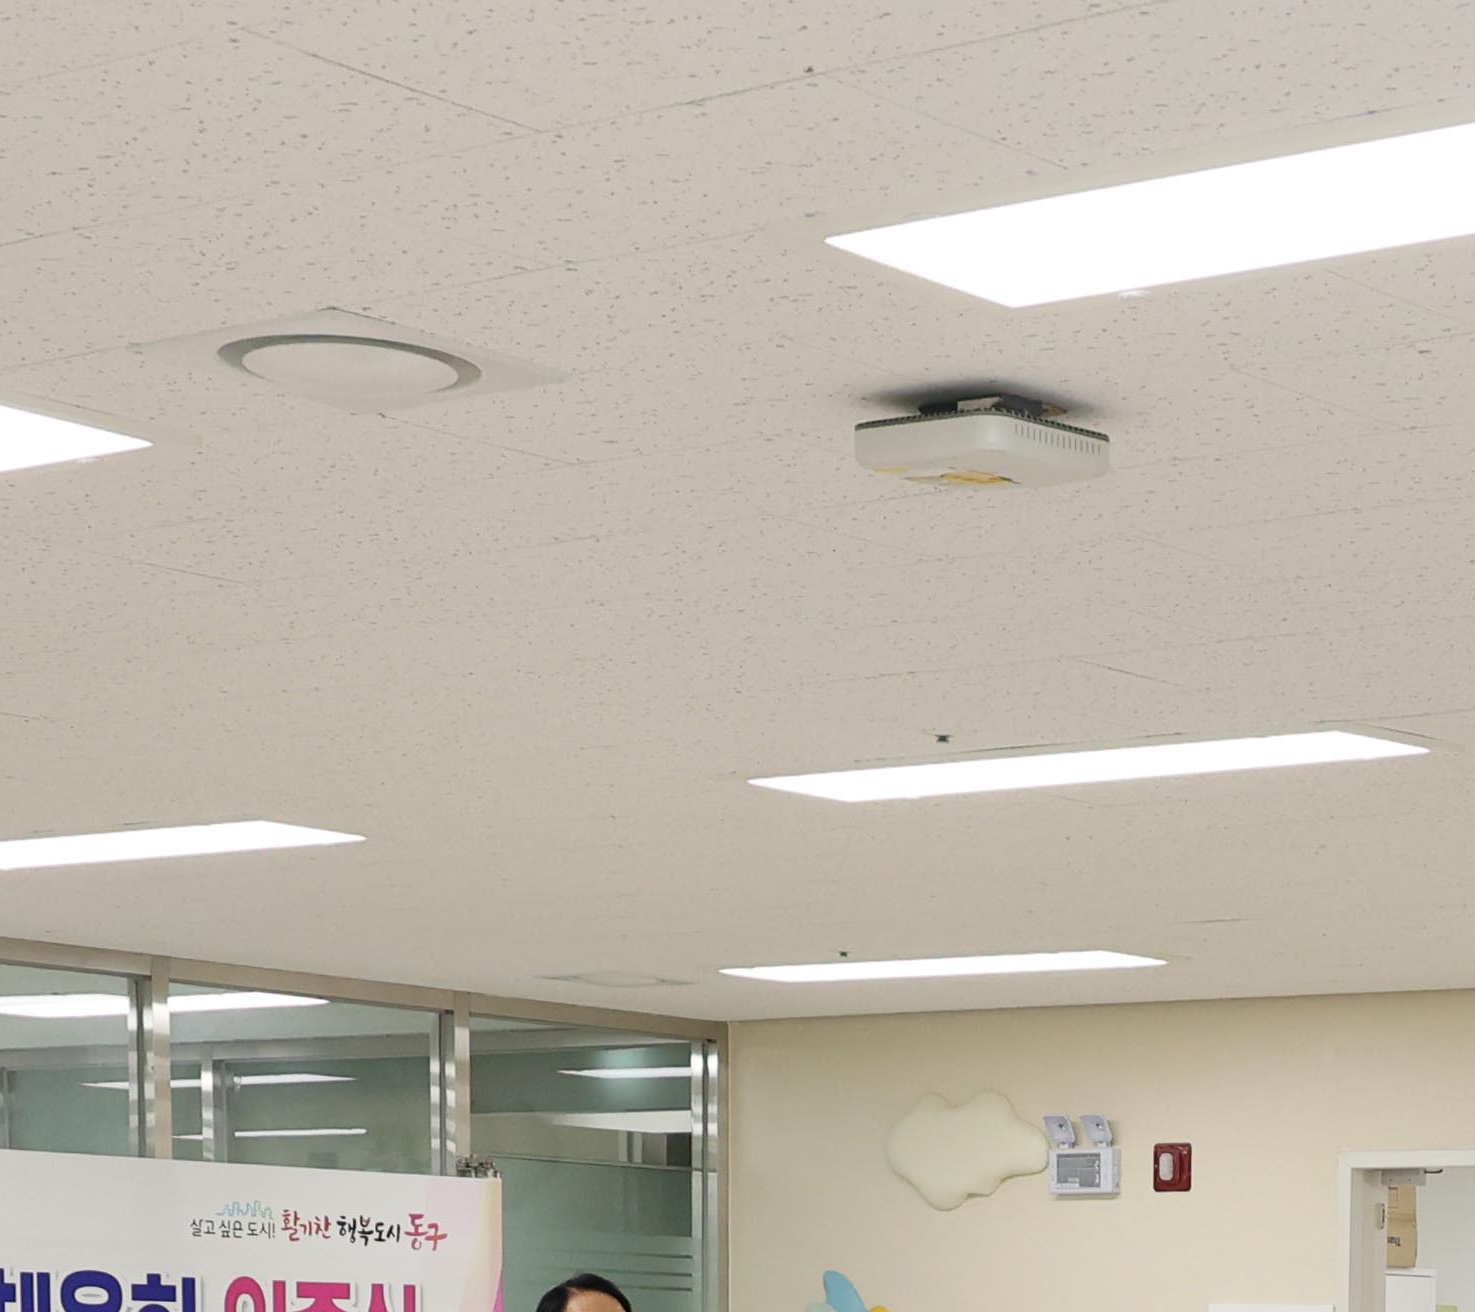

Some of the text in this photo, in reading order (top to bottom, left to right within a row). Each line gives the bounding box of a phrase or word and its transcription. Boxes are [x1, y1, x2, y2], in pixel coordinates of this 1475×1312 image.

[189, 1209, 448, 1251] 살고 싶은 도시! 활기찬 행복도시 동구
